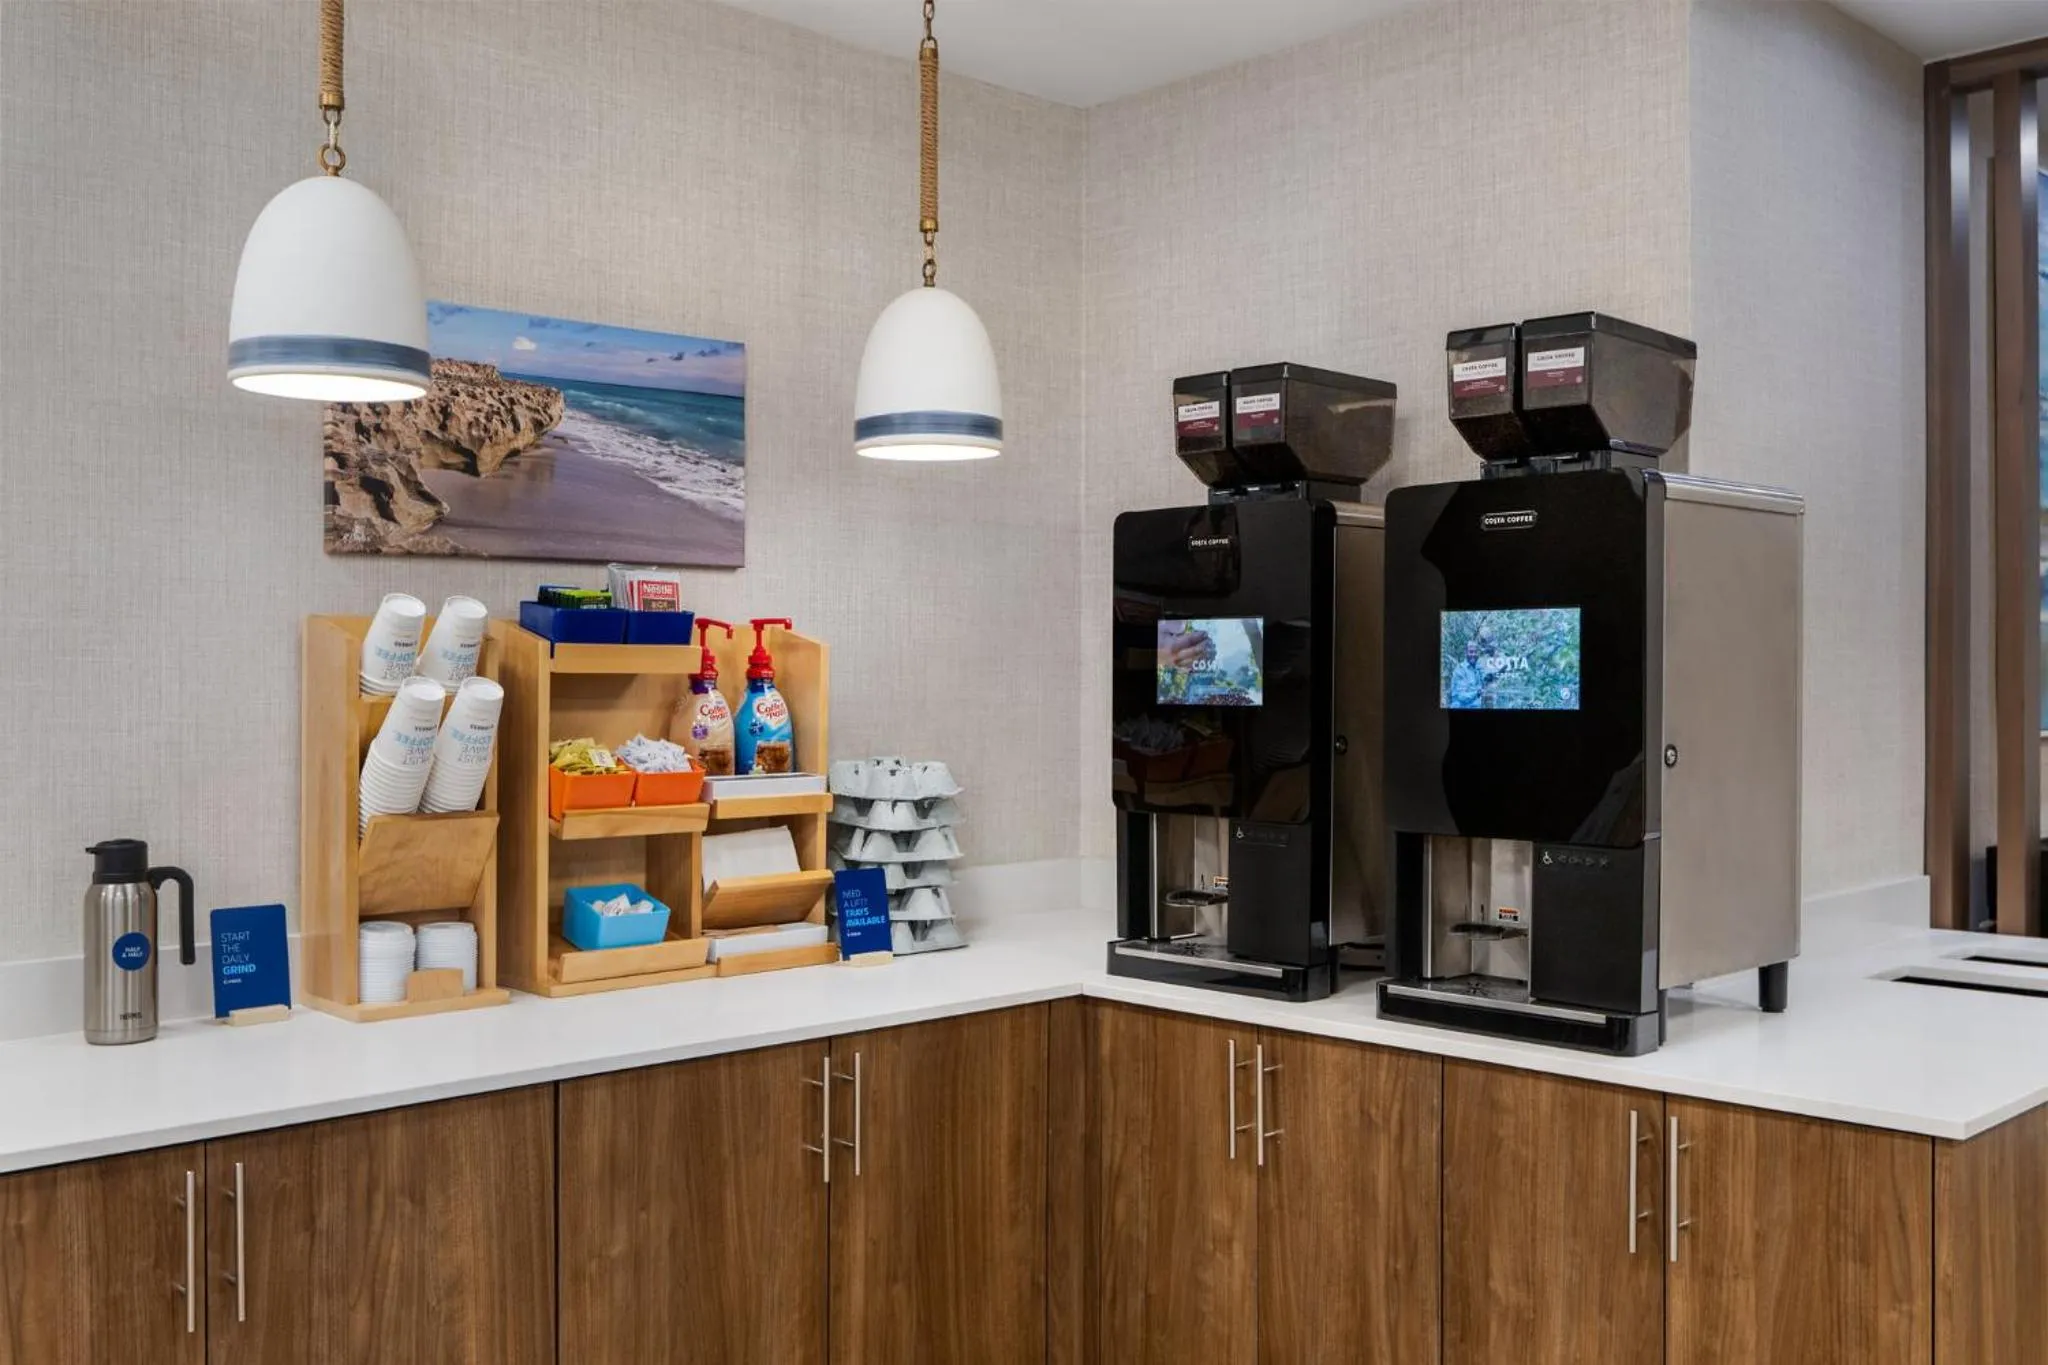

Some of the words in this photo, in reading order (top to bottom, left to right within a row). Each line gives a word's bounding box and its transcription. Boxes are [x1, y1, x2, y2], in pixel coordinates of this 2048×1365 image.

[1506, 515, 1533, 523] COFFEE
[1485, 657, 1529, 670] COSTA
[842, 889, 861, 899] NEED
[846, 907, 869, 917] TRAYS
[846, 915, 885, 928] AVAILABLE
[220, 931, 250, 943] START
[221, 942, 241, 953] THE
[222, 953, 250, 964] DAILY
[223, 964, 256, 975] GRIND
